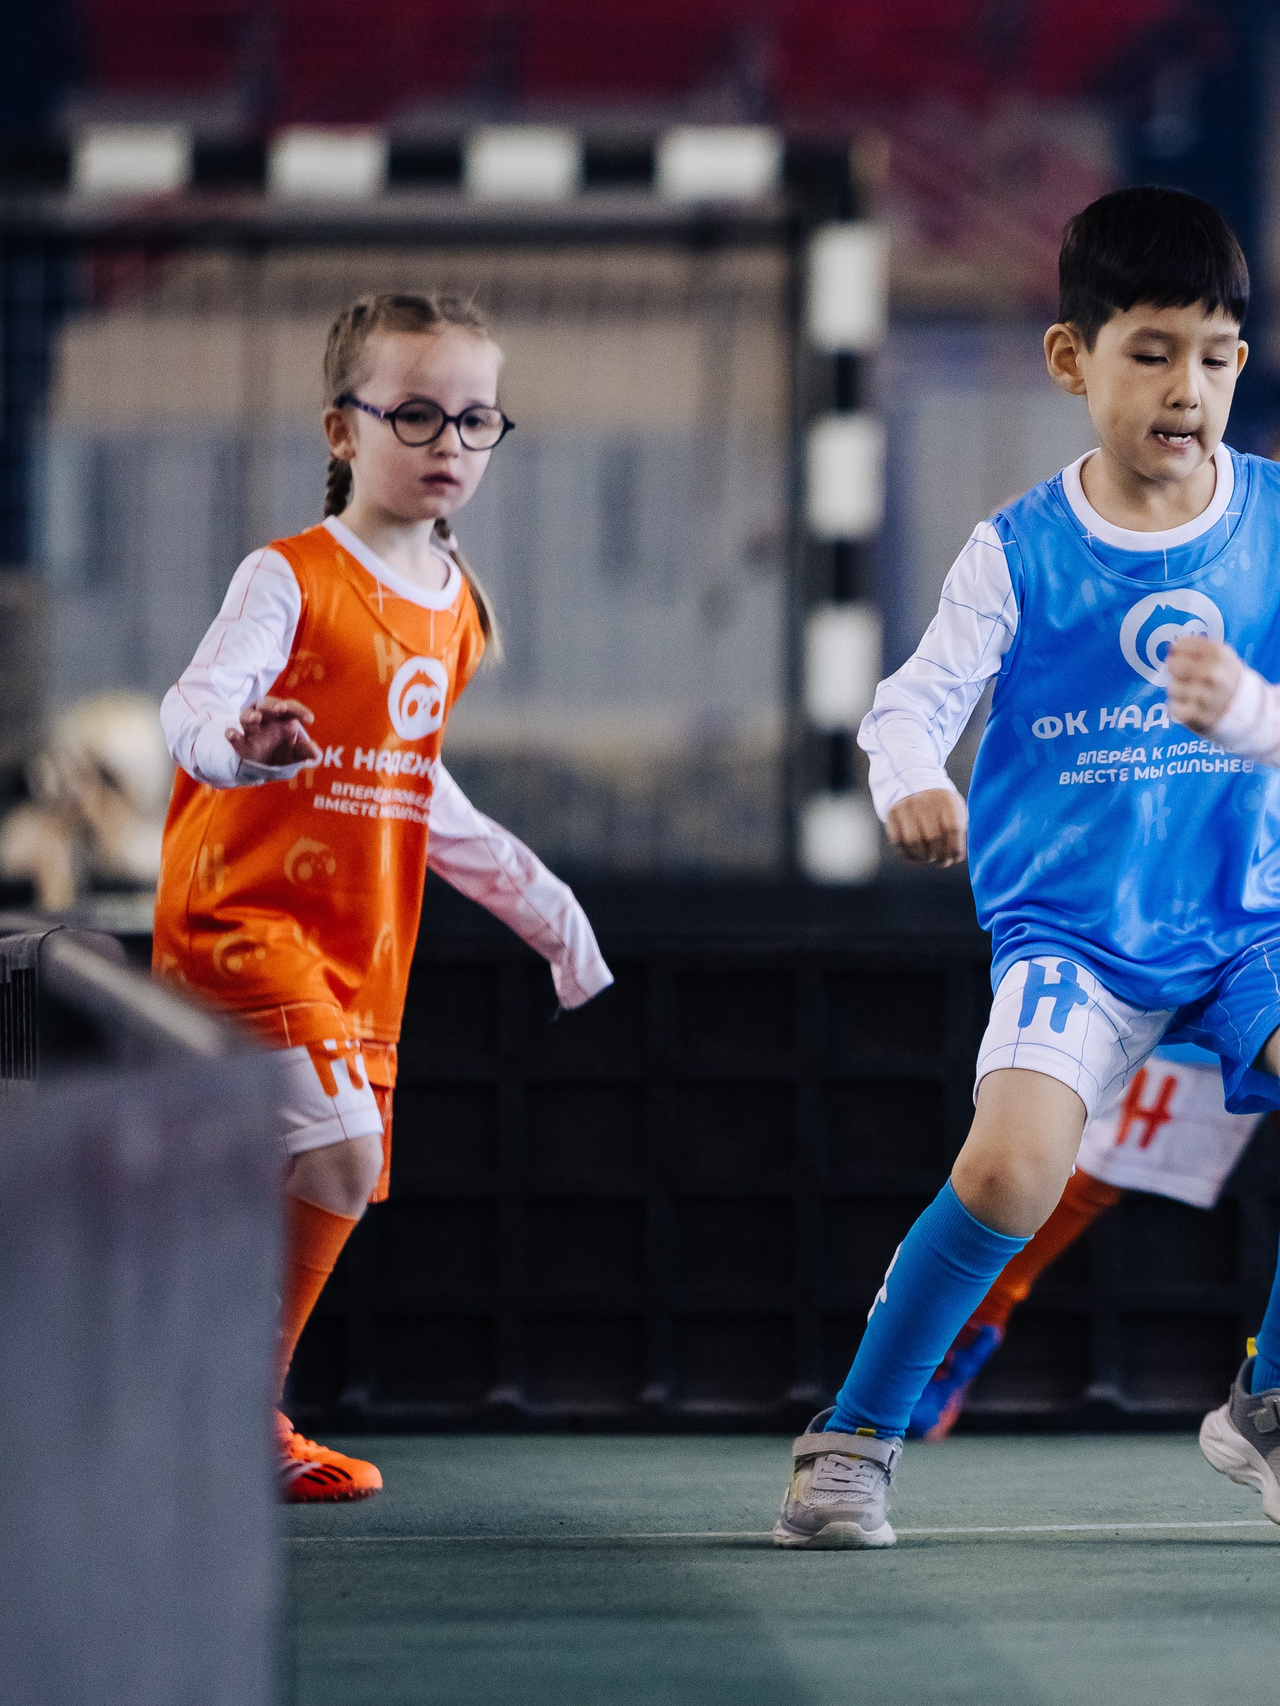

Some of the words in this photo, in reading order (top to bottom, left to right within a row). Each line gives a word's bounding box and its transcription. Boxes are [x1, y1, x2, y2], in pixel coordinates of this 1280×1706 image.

[1031, 710, 1089, 739] ФК
[1098, 702, 1170, 732] НАД
[1077, 746, 1147, 766] ВПЕРЁД
[1152, 746, 1164, 760] К
[1166, 740, 1225, 759] ПОБЕД
[1059, 767, 1129, 785] ВМЕСТЕ
[1134, 764, 1164, 781] МЫ
